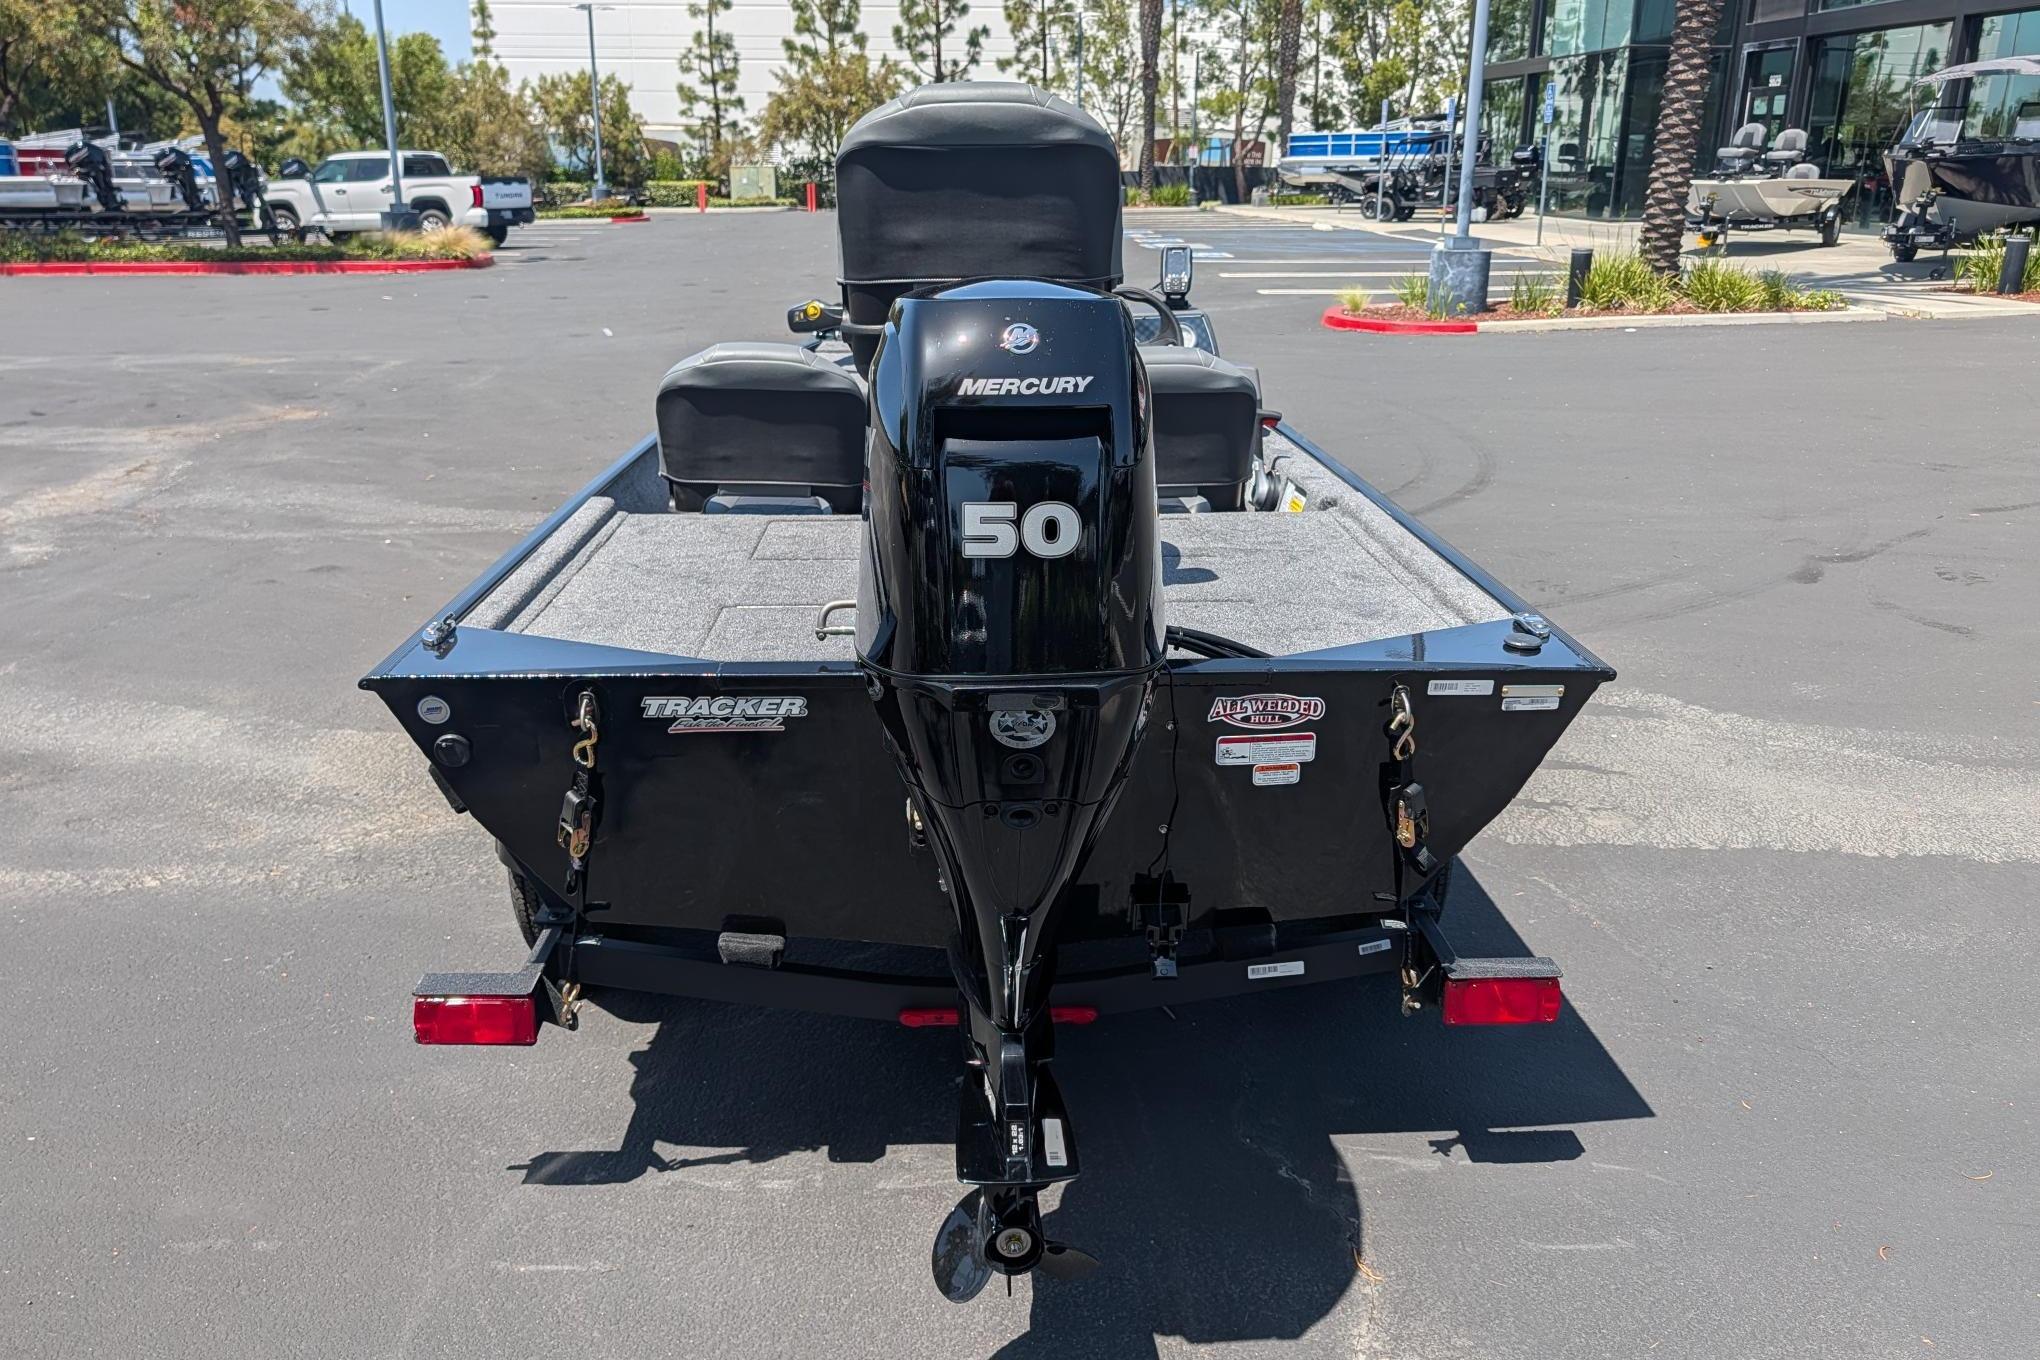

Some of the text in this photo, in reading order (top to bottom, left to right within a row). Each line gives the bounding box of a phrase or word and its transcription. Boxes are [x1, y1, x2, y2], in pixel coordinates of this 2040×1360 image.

[958, 376, 1094, 396] MERCURY
[961, 501, 1082, 559] 50
[642, 697, 807, 717] TRACKER
[1212, 699, 1322, 717] ALL WELDED
[1249, 715, 1283, 723] HULL
[1011, 1145, 1018, 1155] 12
